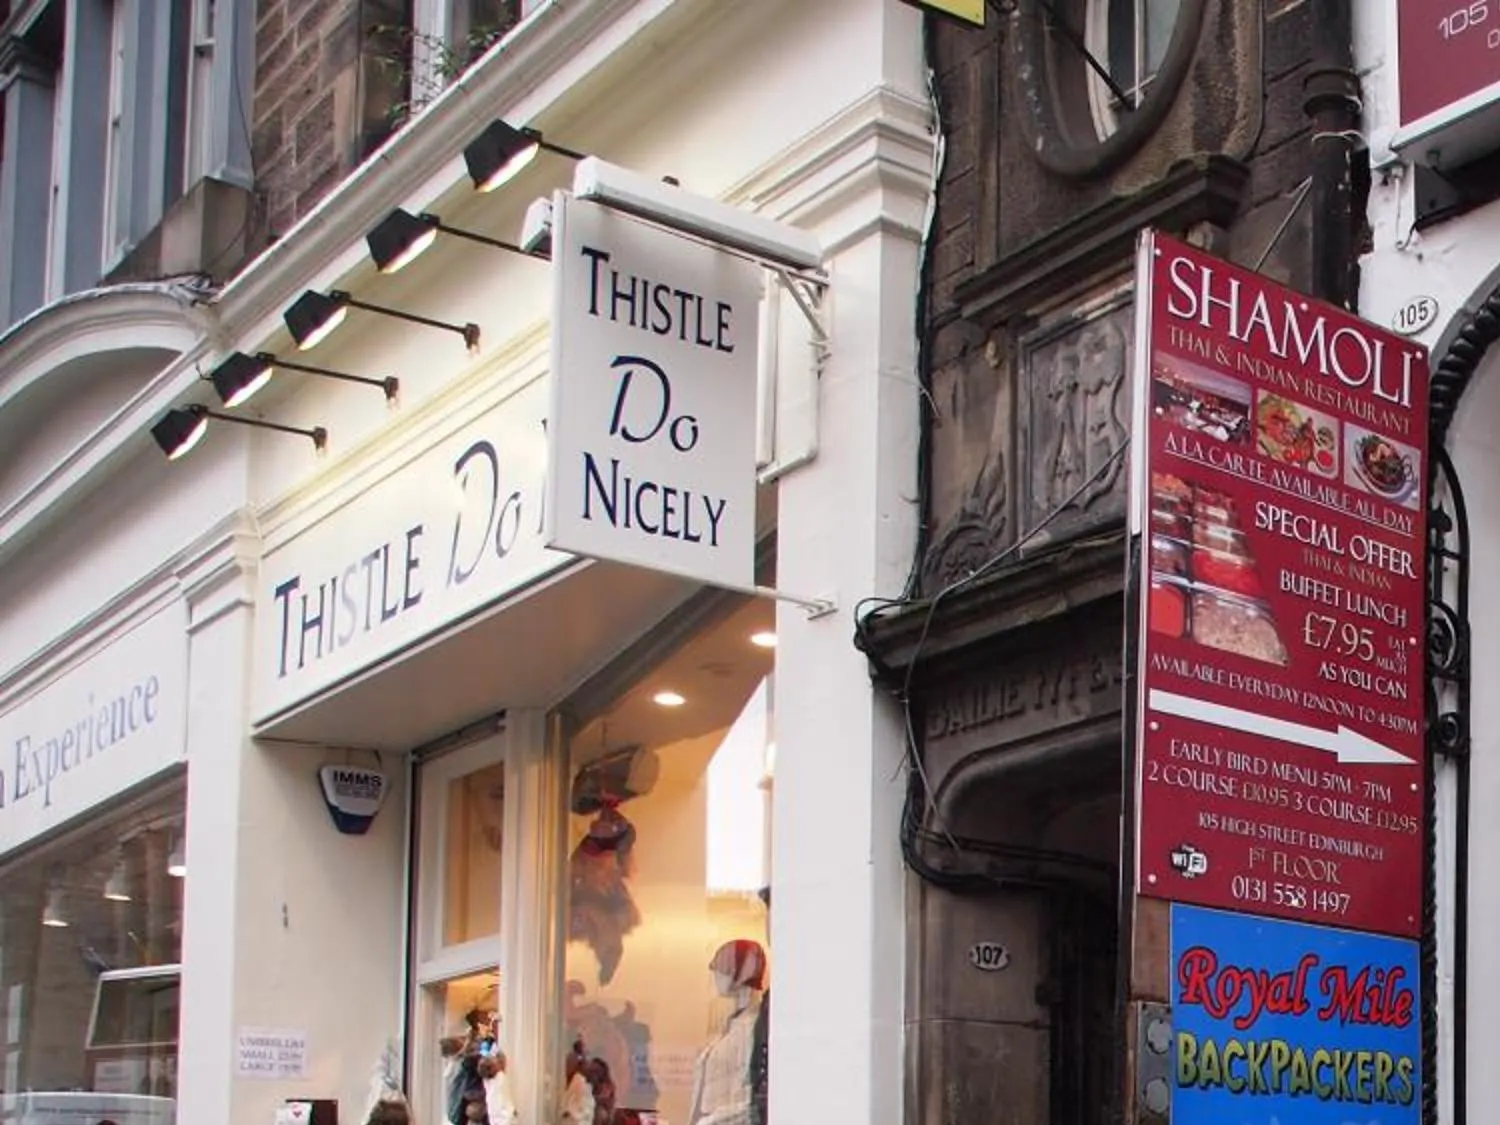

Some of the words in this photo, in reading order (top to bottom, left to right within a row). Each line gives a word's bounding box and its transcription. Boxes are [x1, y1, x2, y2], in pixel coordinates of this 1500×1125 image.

[1438, 0, 1488, 39] 105
[581, 246, 735, 353] THISTLE
[1167, 257, 1413, 408] SHAMOLI
[1399, 304, 1428, 328] 105
[609, 354, 699, 453] Do
[1168, 325, 1211, 358] THAI
[1215, 343, 1231, 366] &
[1236, 353, 1299, 393] INDIAN
[1305, 379, 1411, 435] RESTAURANT
[581, 451, 726, 546] NICELY
[1208, 446, 1264, 480] CARTE
[1270, 468, 1349, 508] AVAILABLE
[1355, 501, 1379, 524] ALL
[1383, 510, 1413, 533] DAY
[1255, 501, 1344, 554] SPECIAL
[1350, 536, 1417, 578] OFFER
[1303, 550, 1333, 572] THAI
[1349, 565, 1392, 591] INDIAN
[274, 524, 424, 679] THISTLE
[1281, 570, 1342, 607] BUFFET
[1347, 592, 1407, 628] LUNCH
[1303, 611, 1375, 662] £7.95
[1152, 653, 1226, 685] AVAILABLE
[1229, 674, 1300, 706] EVERYDAY
[1358, 705, 1376, 723] TO
[1318, 663, 1337, 682] AS
[1341, 669, 1372, 691] YOU
[1375, 675, 1407, 699] CAN
[13, 673, 161, 807] Experience
[1171, 739, 1223, 768] EARLY
[1228, 751, 1268, 777] BIRD
[1271, 762, 1317, 789] MENU
[1321, 776, 1351, 794] 5PM
[1363, 781, 1392, 802] 7PM
[1148, 761, 1159, 781] 2
[1163, 767, 1238, 798] COURSE
[1294, 794, 1303, 811] 3
[1306, 796, 1373, 826] COURSE
[1199, 812, 1218, 830] 105
[1220, 815, 1256, 836] HIGH
[1259, 822, 1305, 846] STREET
[1309, 829, 1383, 861] EDINBURGH
[1272, 853, 1342, 884] FLOOR
[1231, 876, 1267, 902] 0131
[1273, 884, 1307, 908] 558
[1312, 888, 1350, 915] 1497
[975, 946, 1002, 964] 107
[1178, 946, 1320, 1030] Royal
[1318, 965, 1414, 1028] Mile
[1175, 1032, 1414, 1106] BACKPACKERS
